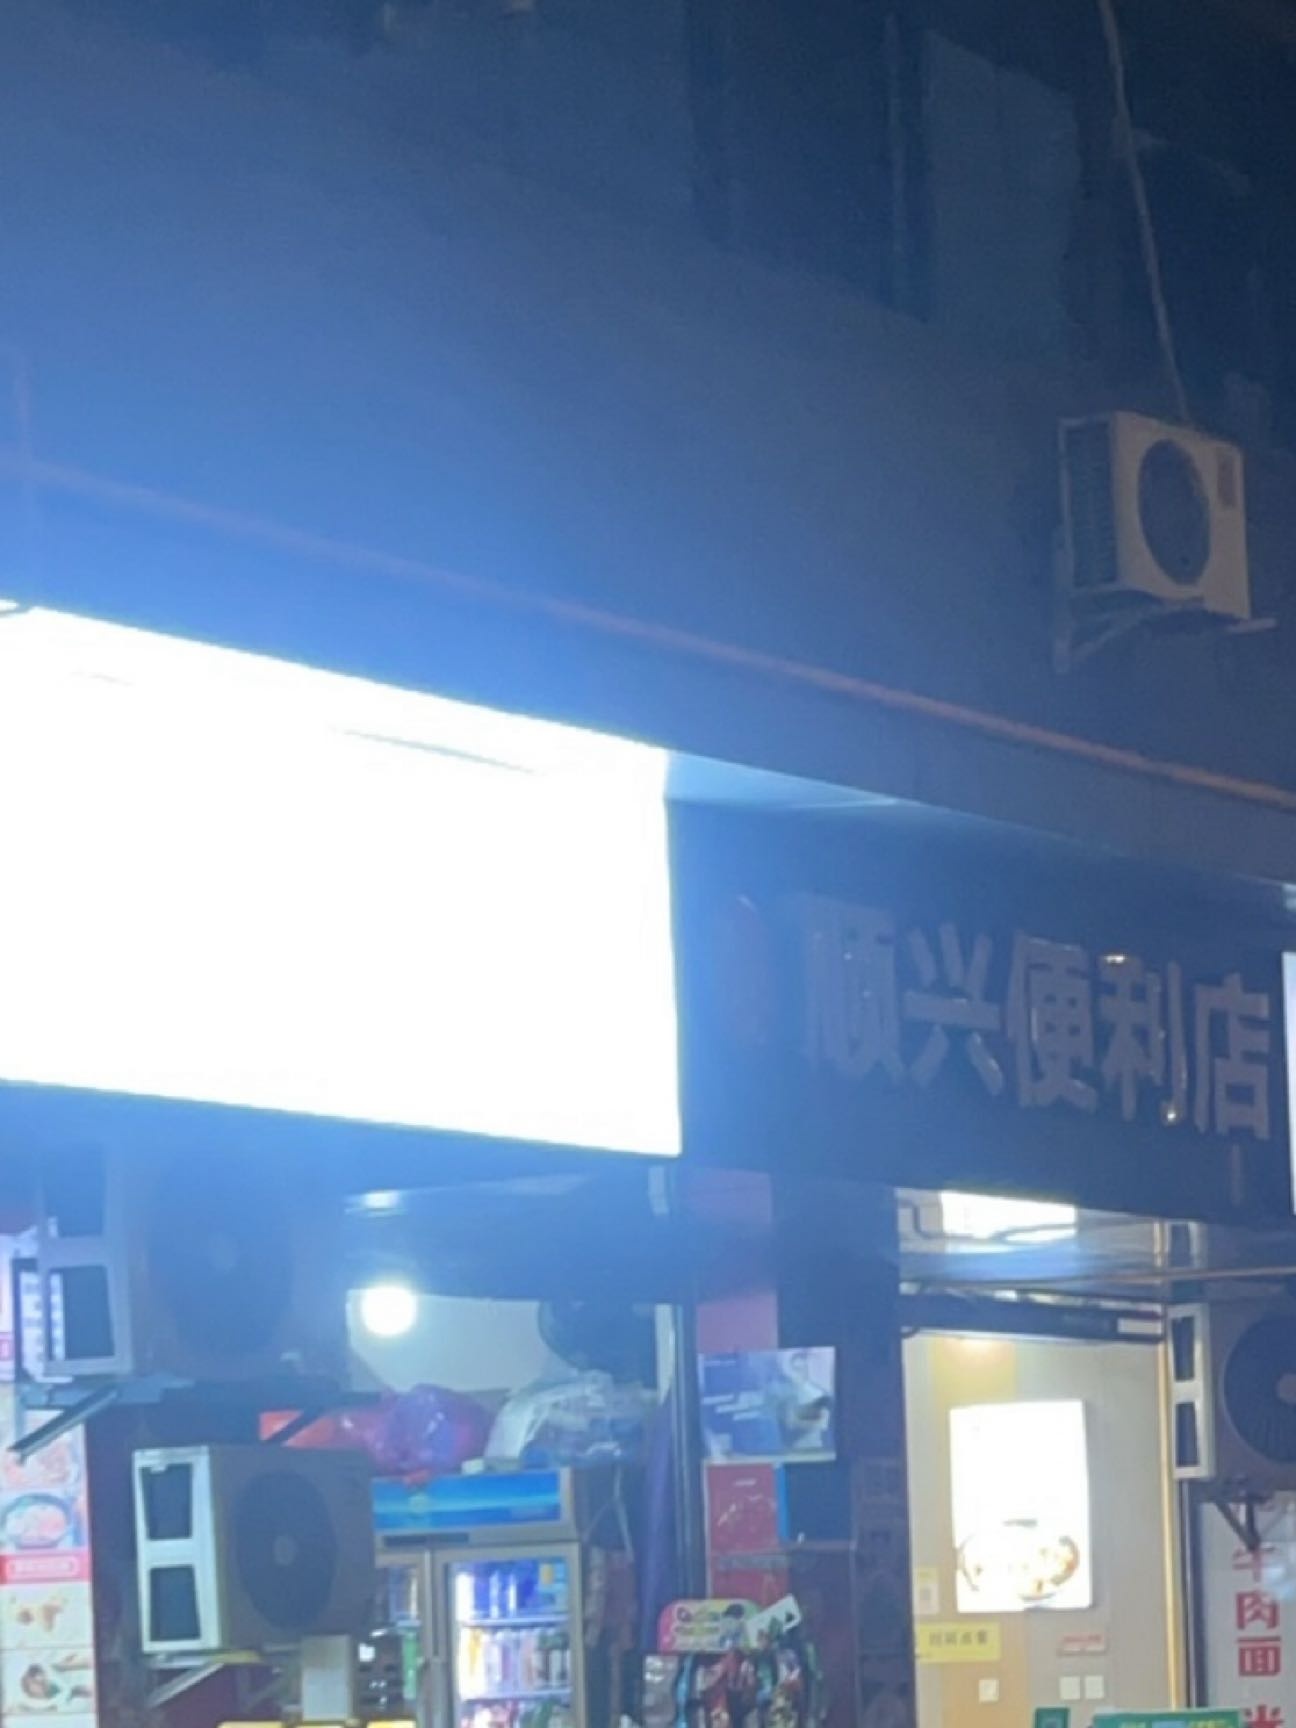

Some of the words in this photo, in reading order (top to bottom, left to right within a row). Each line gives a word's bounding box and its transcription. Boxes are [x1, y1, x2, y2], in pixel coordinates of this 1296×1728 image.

[806, 896, 1272, 1142] 顺兴便利店
